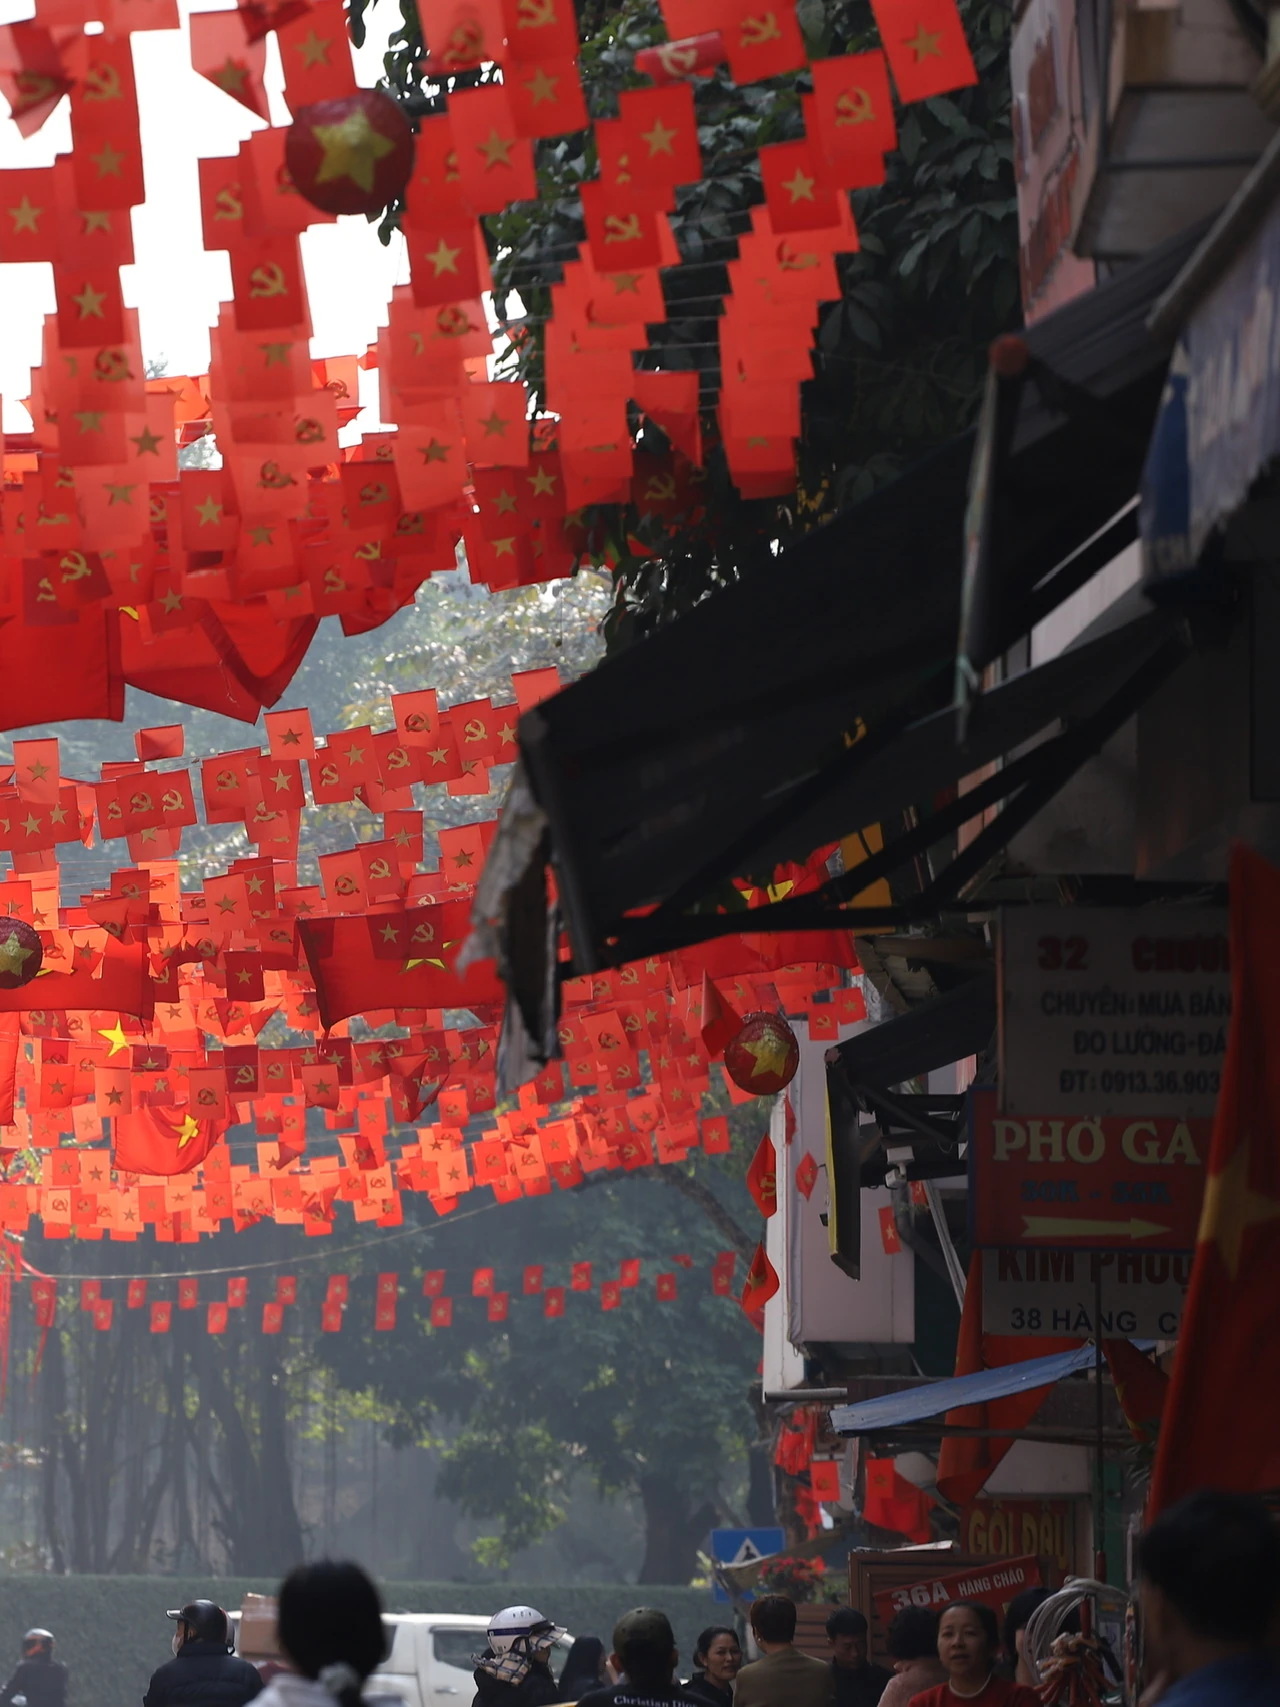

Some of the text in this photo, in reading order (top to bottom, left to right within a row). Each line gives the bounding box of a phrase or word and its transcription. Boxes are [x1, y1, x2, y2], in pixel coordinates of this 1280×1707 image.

[1037, 935, 1089, 971] 32
[1138, 990, 1184, 1017] MUA
[1073, 1029, 1106, 1055] ĐO
[991, 1115, 1202, 1165] PHỞ GÀ
[1020, 1179, 1080, 1203] 30K
[998, 1249, 1074, 1283] KIM
[1010, 1302, 1178, 1335] 38 HÀNG C
[891, 1567, 1025, 1611] 36A HÀNG CHÁO
[613, 1695, 669, 1707] Christian
